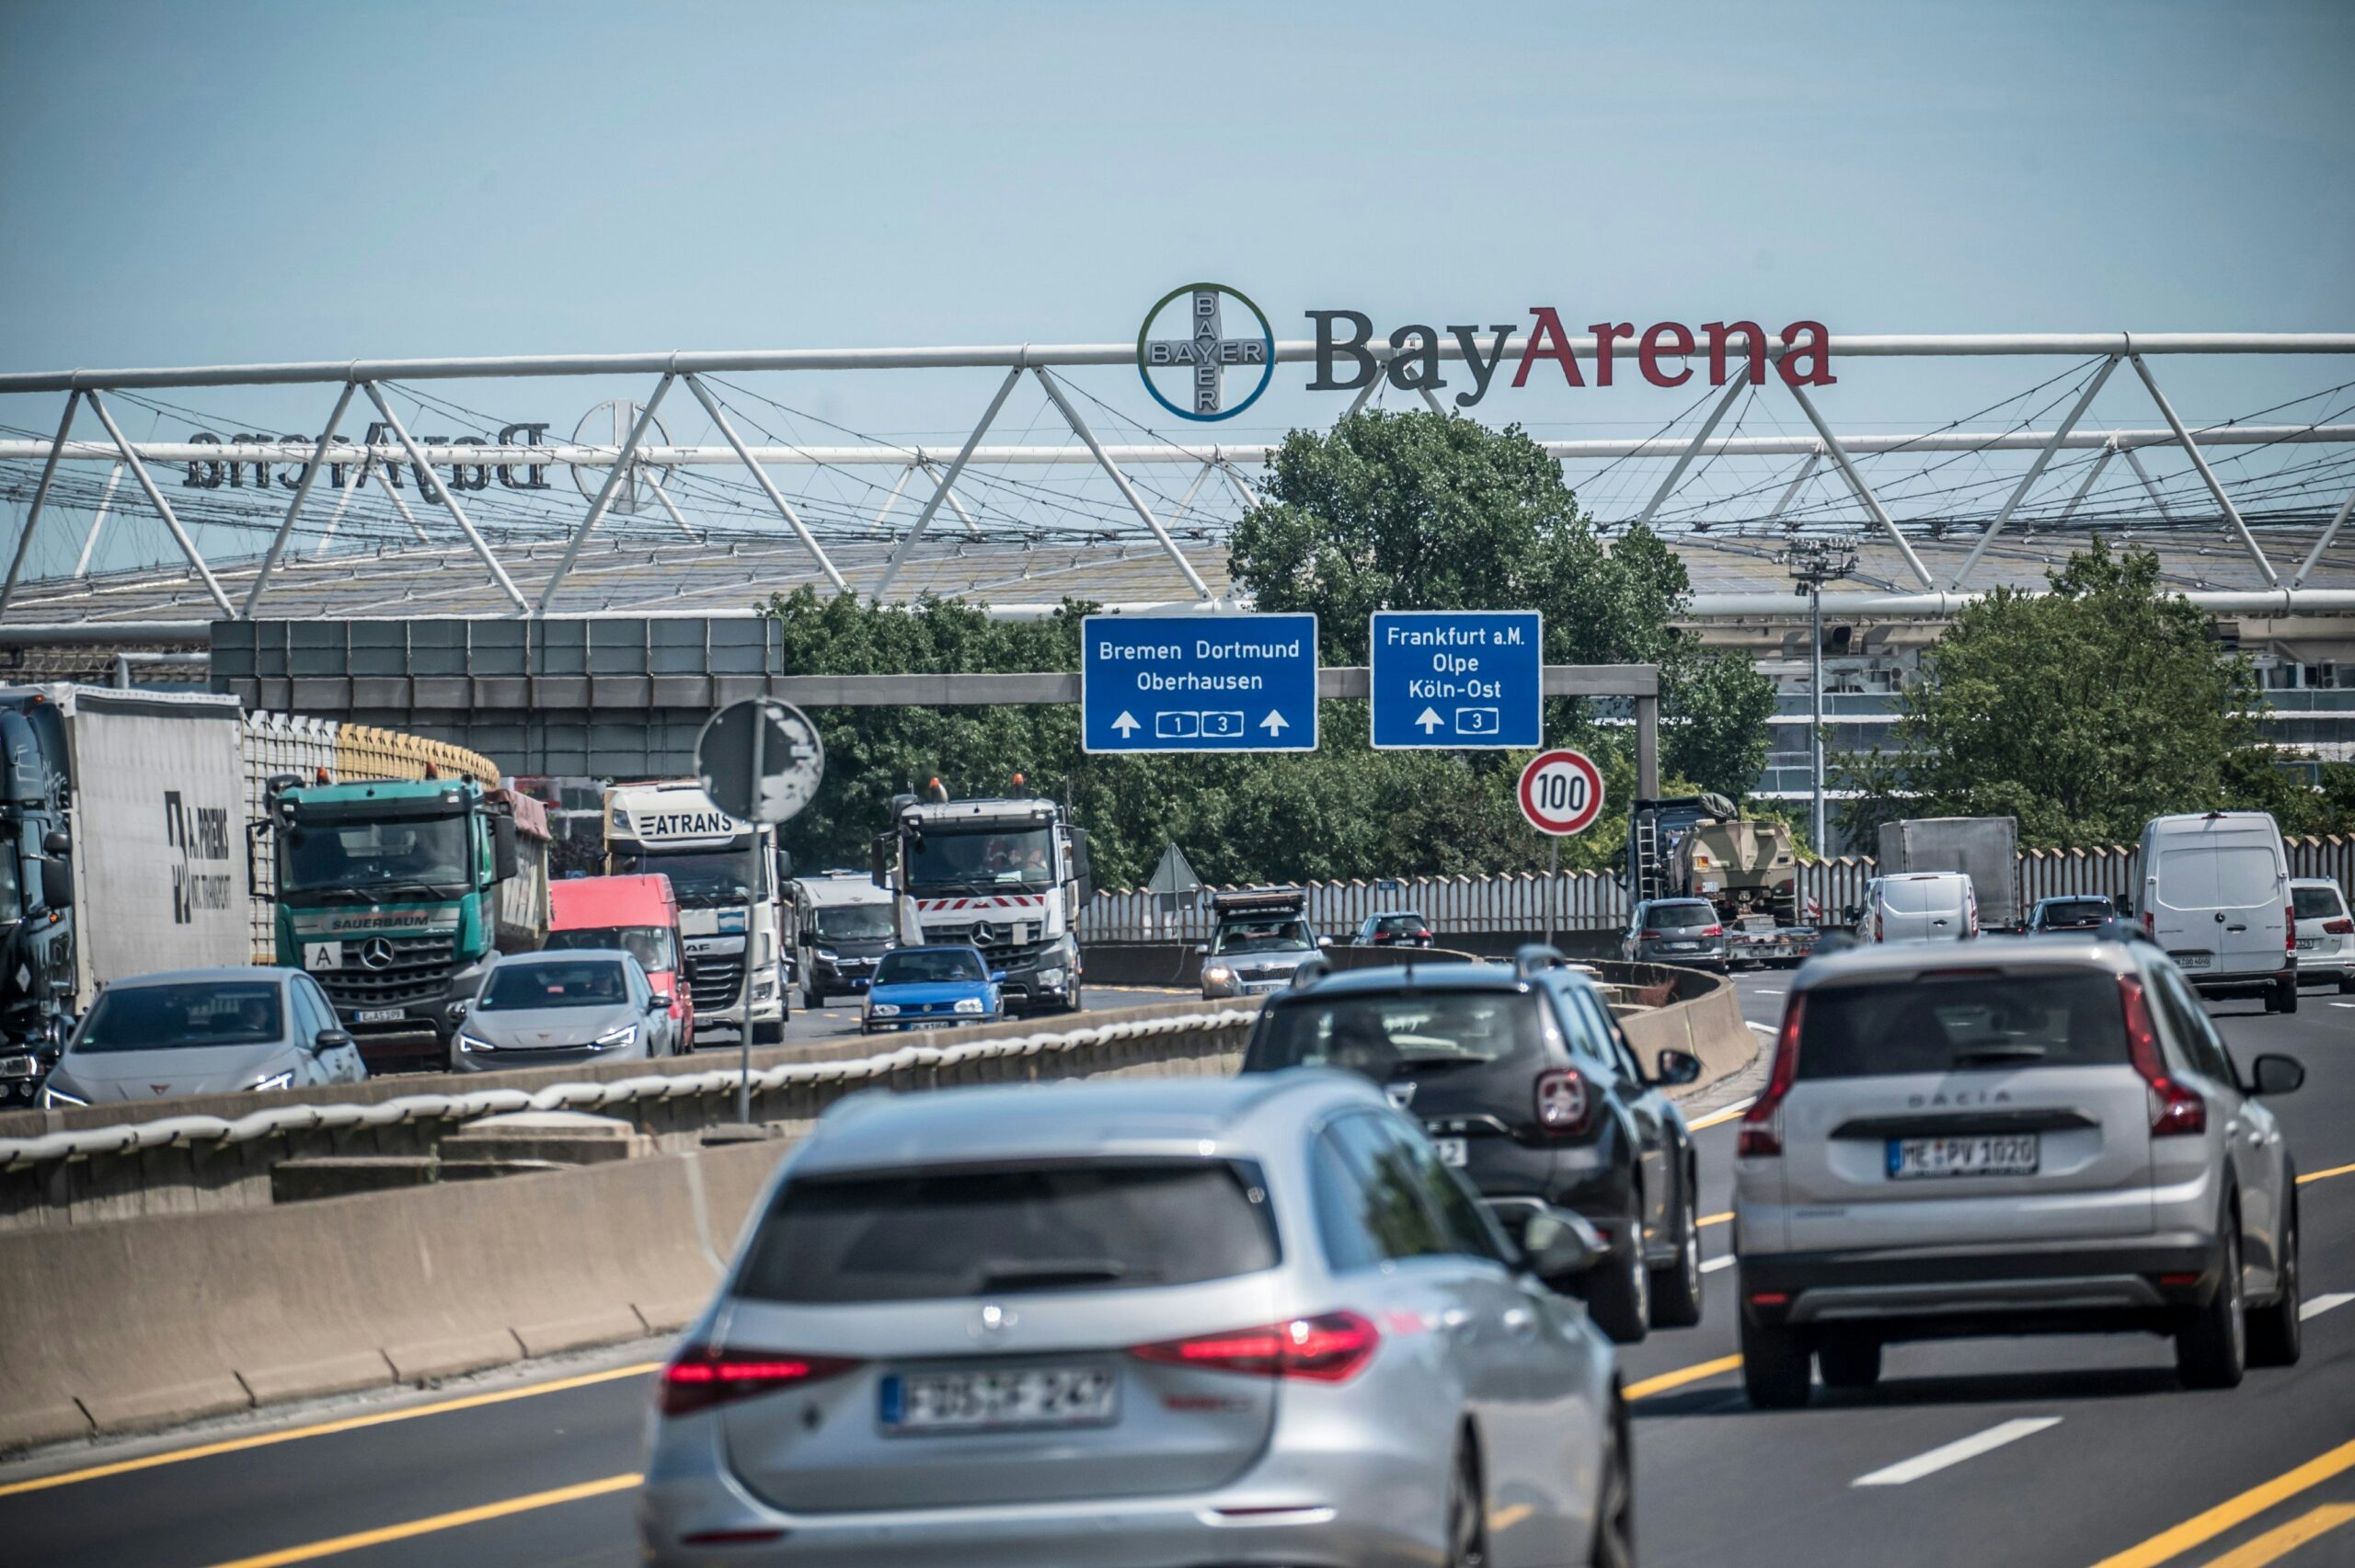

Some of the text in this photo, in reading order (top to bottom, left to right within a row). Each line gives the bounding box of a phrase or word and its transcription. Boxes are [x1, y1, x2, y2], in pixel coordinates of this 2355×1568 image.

[1151, 342, 1262, 363] BAYER
[1196, 296, 1218, 410] BAYER
[1304, 306, 1837, 407] BayArena
[1387, 627, 1525, 646] Frankfurt a.M.
[1099, 640, 1300, 660] Bremen Dortmund
[1432, 653, 1479, 677] Olpe
[1137, 672, 1263, 691] Oberhausen
[1408, 680, 1501, 699] Köln-Ost
[1175, 716, 1228, 733] 1 3
[1472, 713, 1483, 729] 3
[1537, 773, 1585, 811] 100
[332, 916, 430, 931] SAUERBAUM
[316, 946, 332, 967] A
